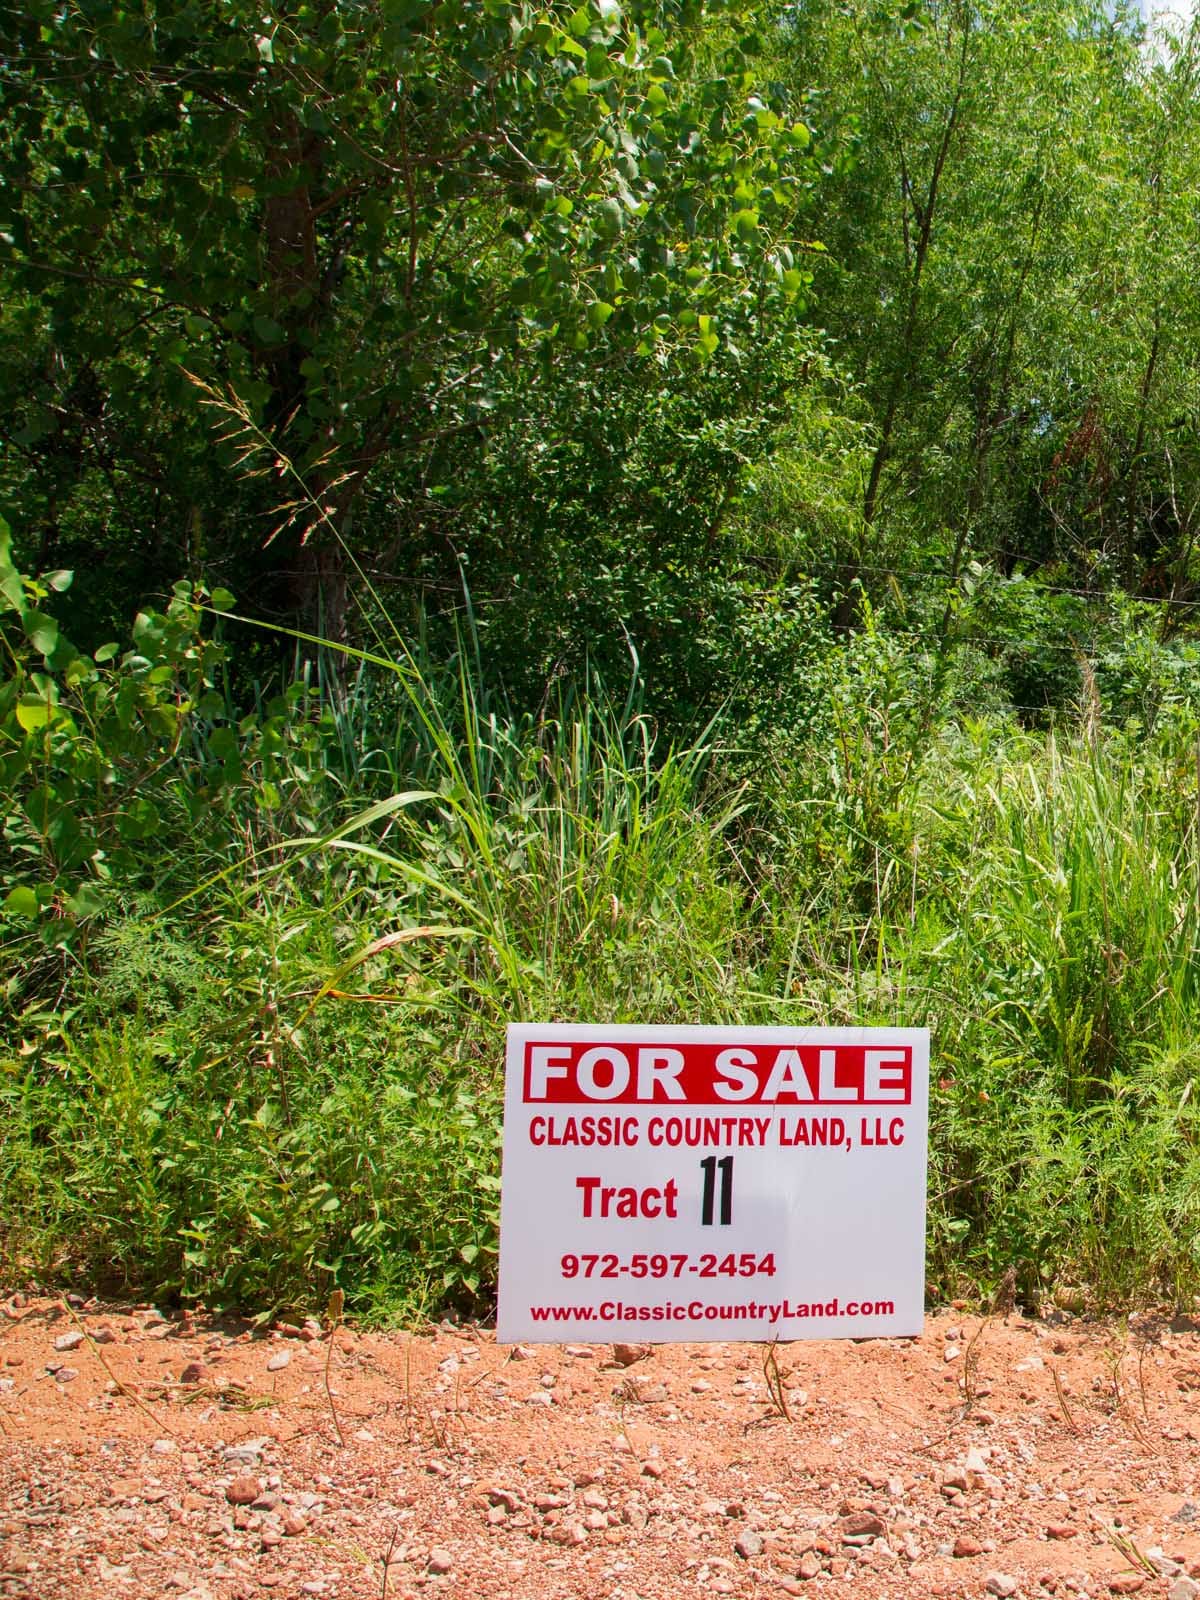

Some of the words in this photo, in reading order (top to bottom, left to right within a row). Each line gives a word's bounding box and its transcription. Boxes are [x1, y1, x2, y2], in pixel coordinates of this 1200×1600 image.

[528, 1046, 688, 1101] FOR
[712, 1047, 907, 1102] SALE
[529, 1116, 639, 1146] CLASSIC
[647, 1116, 773, 1147] COUNTRY
[779, 1117, 852, 1152] LAND,
[860, 1118, 905, 1147] LLC
[576, 1176, 678, 1218] Tract
[700, 1155, 735, 1226] 11
[560, 1252, 777, 1279] 972-597-2454
[530, 1298, 895, 1323] www.ClassicCountryLand.com
